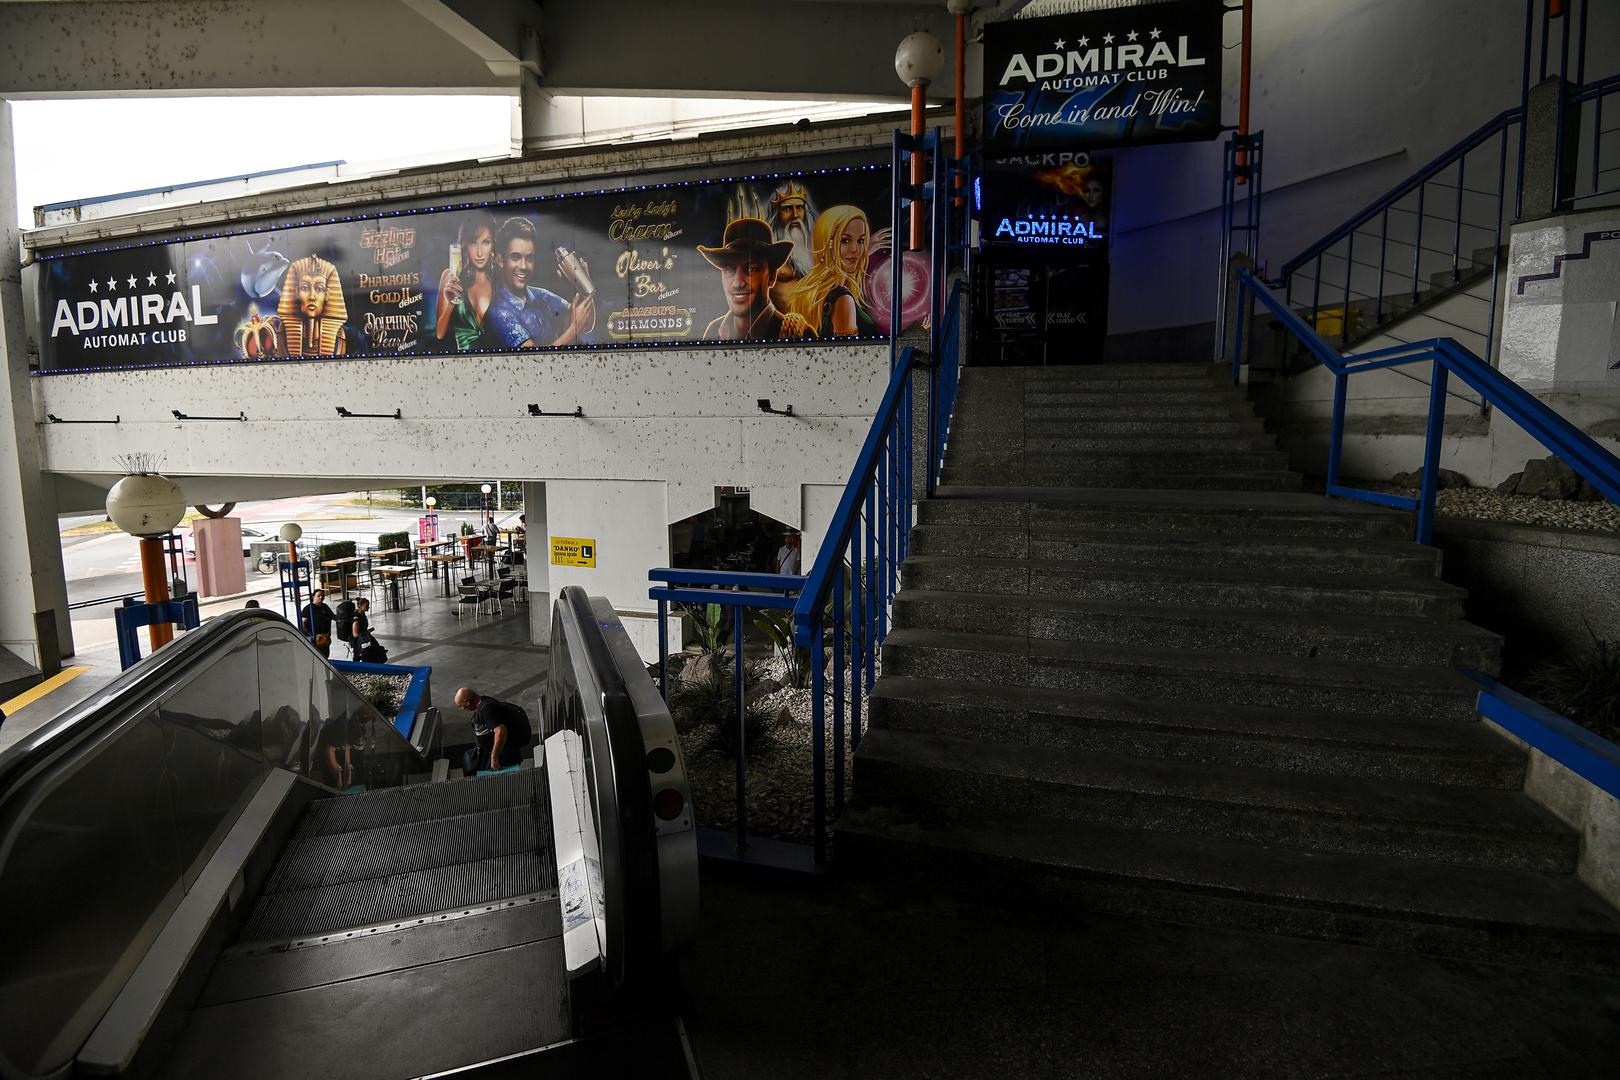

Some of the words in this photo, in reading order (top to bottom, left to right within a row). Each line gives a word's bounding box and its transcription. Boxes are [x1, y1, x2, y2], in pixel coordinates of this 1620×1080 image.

[999, 35, 1206, 86] ADMIRAL
[1041, 73, 1120, 91] AUTOMAT
[1127, 68, 1169, 82] CLUB
[998, 103, 1062, 130] Come
[1067, 104, 1091, 123] in
[1093, 94, 1142, 121] and
[1143, 87, 1205, 116] Win!
[360, 228, 417, 249] Sizzling
[995, 218, 1103, 239] ADMIRAL
[1017, 236, 1060, 244] AUTOMAT
[1062, 237, 1085, 245] CLUB
[359, 273, 420, 288] PHARAOH'S
[635, 275, 667, 297] Bar
[657, 288, 681, 300] deluxe
[370, 289, 401, 304] GOLD
[398, 293, 424, 308] deluxe
[51, 285, 218, 337] ADMIRAL
[364, 312, 418, 335] DOLPHIN'S
[618, 319, 683, 331] DIAMONDS
[83, 332, 147, 349] AUTOMAT
[151, 329, 187, 344] CLUB
[372, 331, 409, 349] Pearl
